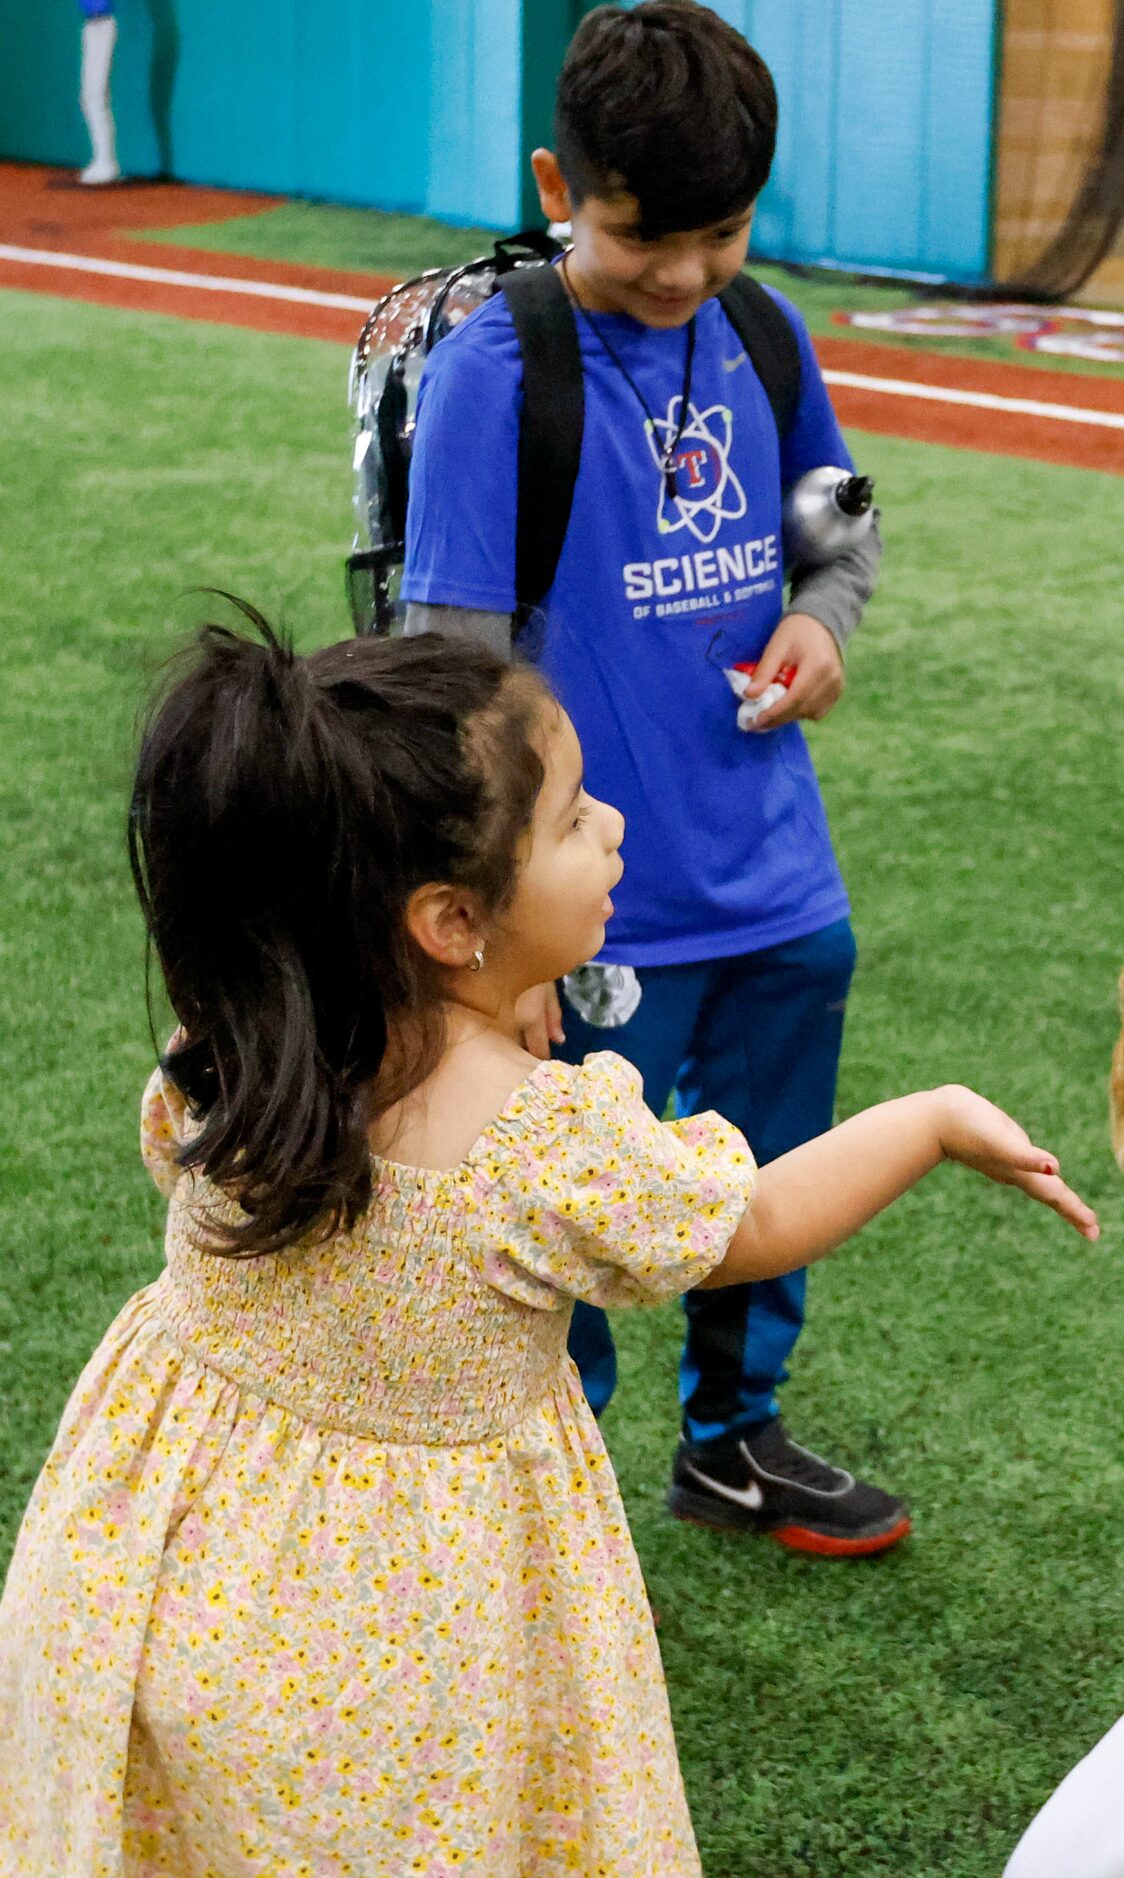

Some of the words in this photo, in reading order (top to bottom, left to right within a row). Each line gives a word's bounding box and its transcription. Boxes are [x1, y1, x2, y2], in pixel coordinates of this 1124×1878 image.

[678, 450, 706, 488] T
[624, 536, 777, 599] SCIENCE
[633, 606, 650, 619] OF
[656, 595, 720, 617] BASEBALL
